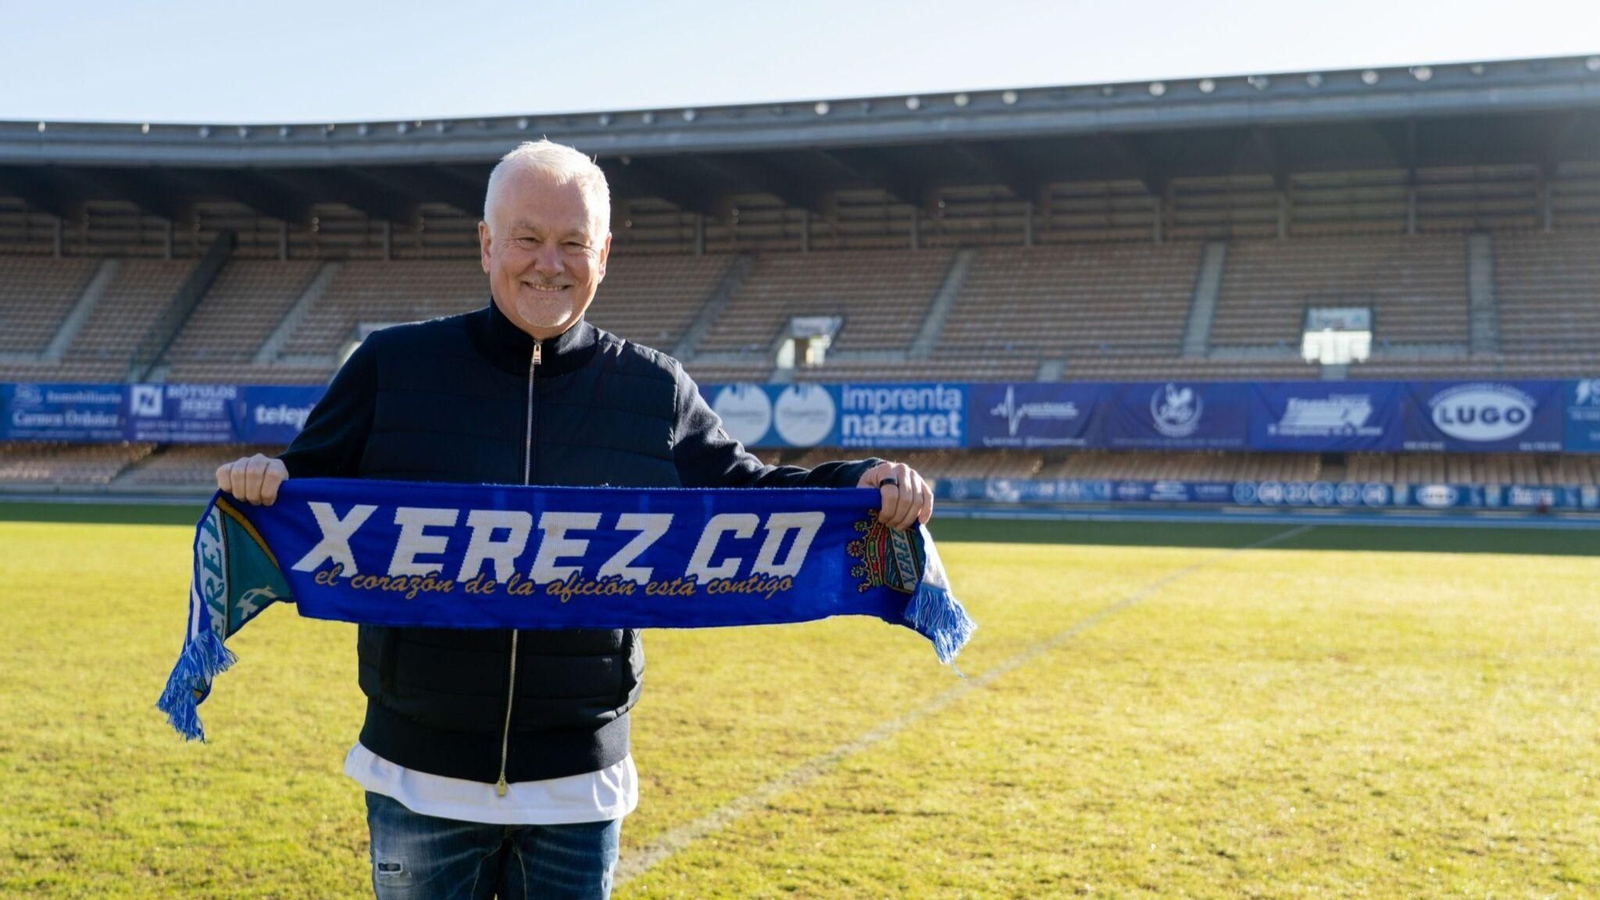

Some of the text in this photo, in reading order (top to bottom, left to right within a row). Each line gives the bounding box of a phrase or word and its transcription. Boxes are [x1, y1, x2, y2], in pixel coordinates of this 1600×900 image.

[841, 385, 962, 413] imprenta
[255, 404, 316, 431] telep
[841, 411, 962, 436] nazaret
[1439, 405, 1526, 425] LUGO
[291, 501, 826, 584] XEREZ CD
[314, 562, 794, 604] el corazón de la afición está contigo
